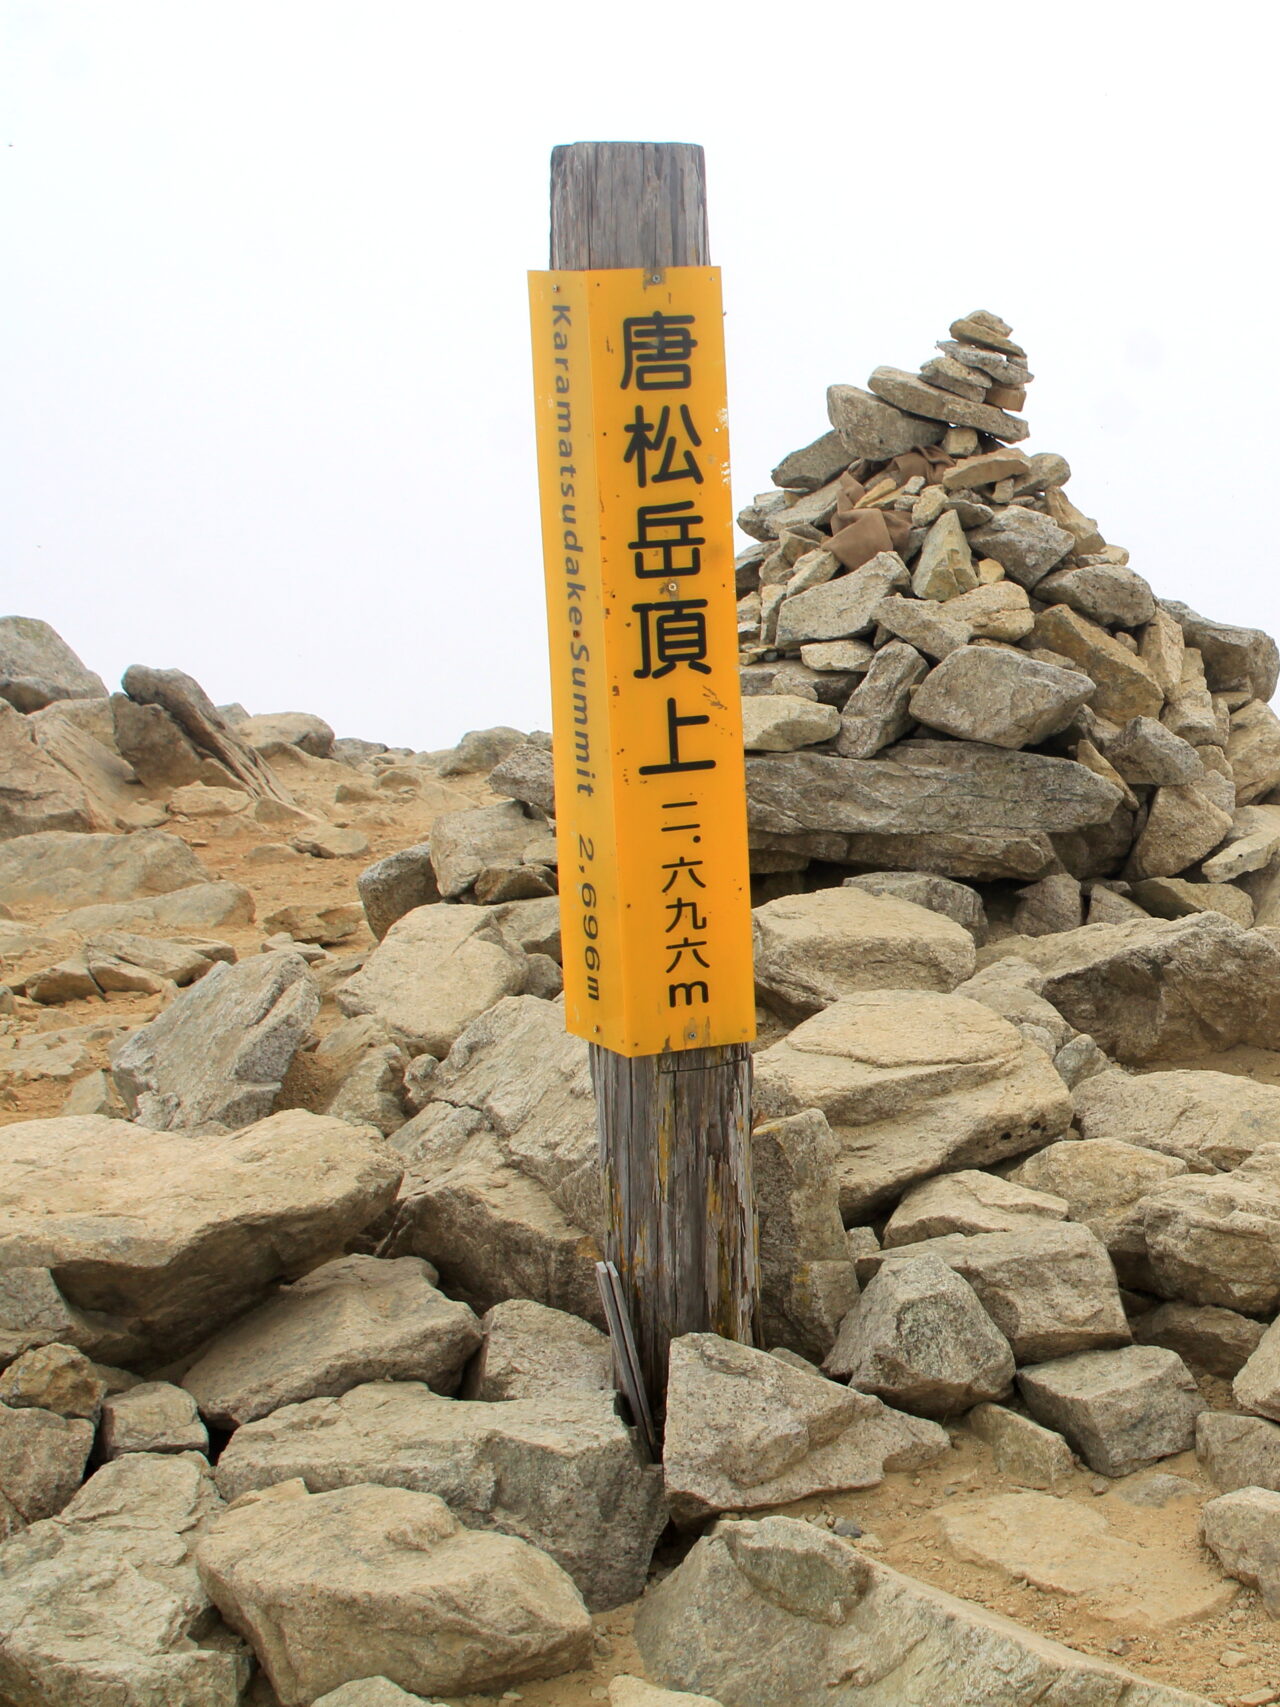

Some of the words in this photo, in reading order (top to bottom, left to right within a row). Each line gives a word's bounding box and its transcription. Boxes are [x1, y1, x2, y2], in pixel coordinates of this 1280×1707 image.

[550, 303, 587, 626] Karamatsudake
[619, 310, 716, 776] 唐松岳頂上
[570, 642, 594, 797] Summit
[578, 833, 600, 1001] 2,696m
